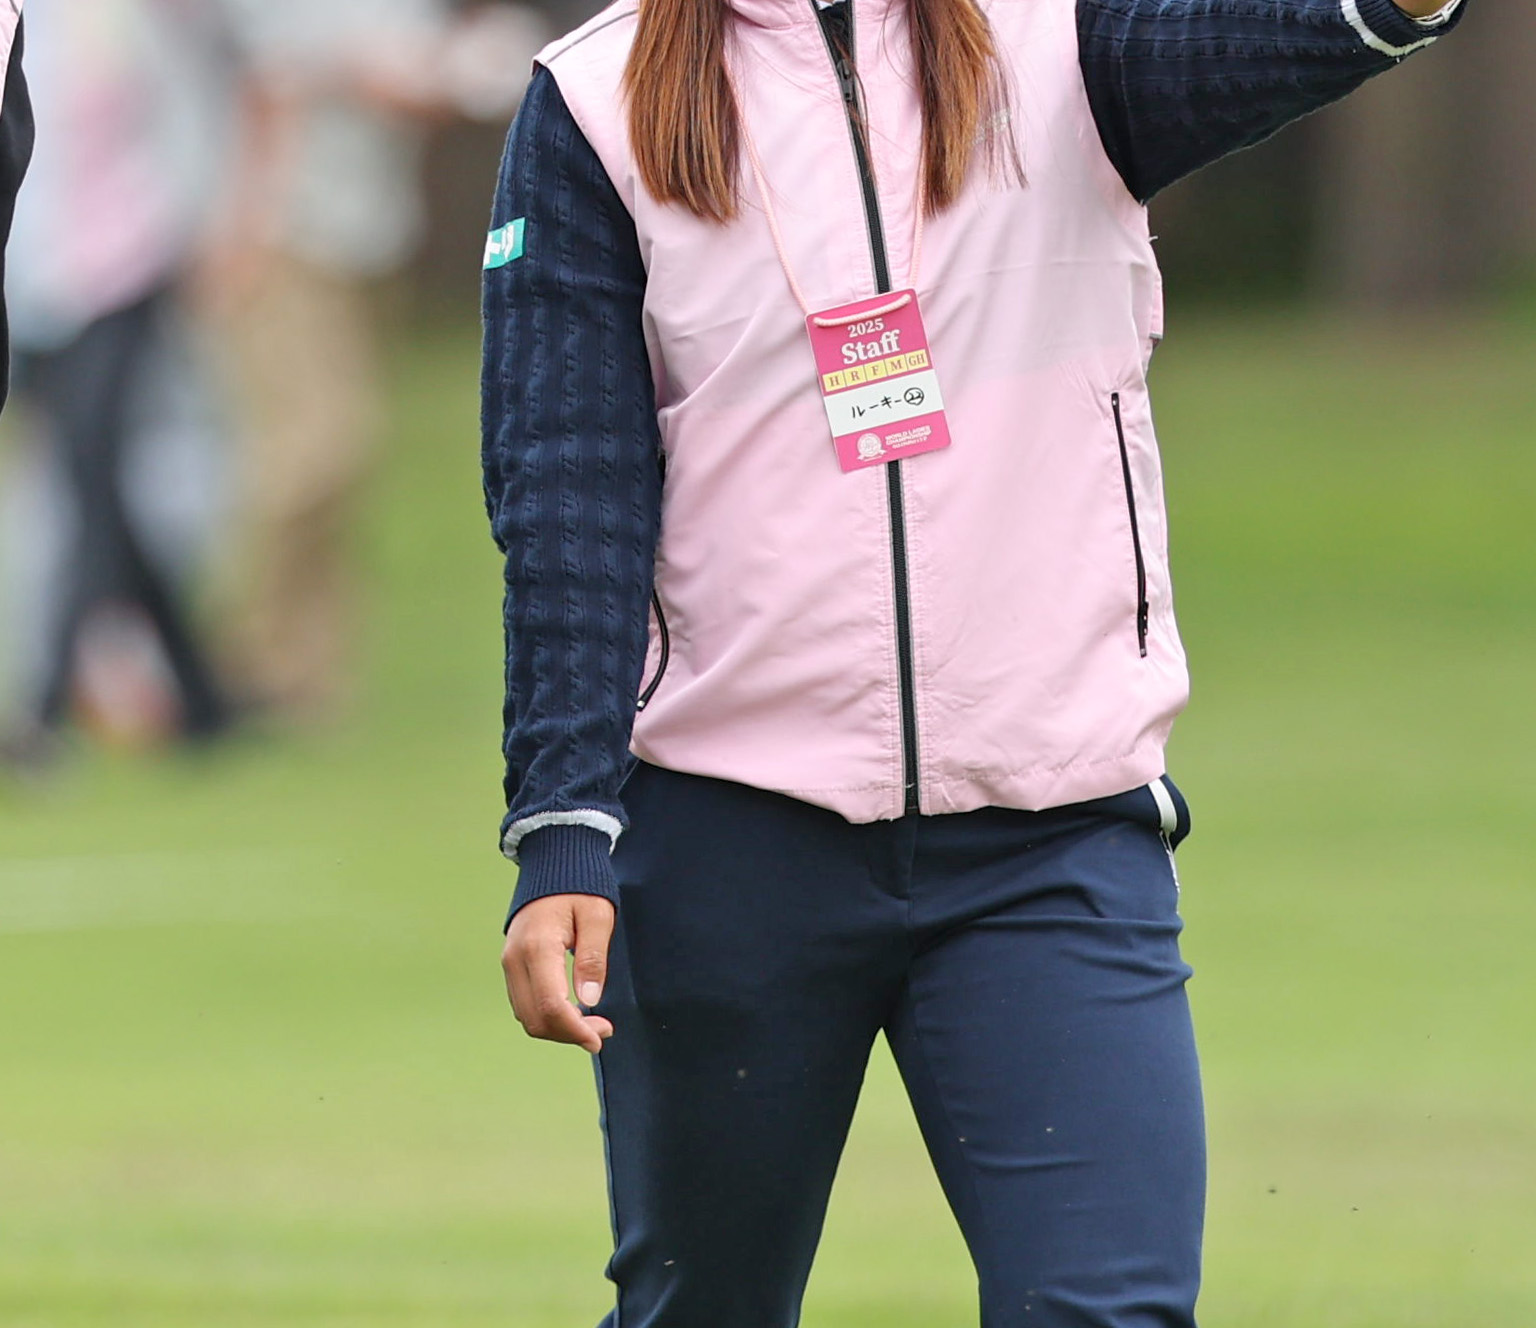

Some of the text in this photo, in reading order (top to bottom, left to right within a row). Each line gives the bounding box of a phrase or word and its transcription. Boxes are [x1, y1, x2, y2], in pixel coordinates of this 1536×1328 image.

[847, 318, 885, 338] 2025
[841, 329, 901, 365] Staff
[828, 353, 925, 388] H R F M GH
